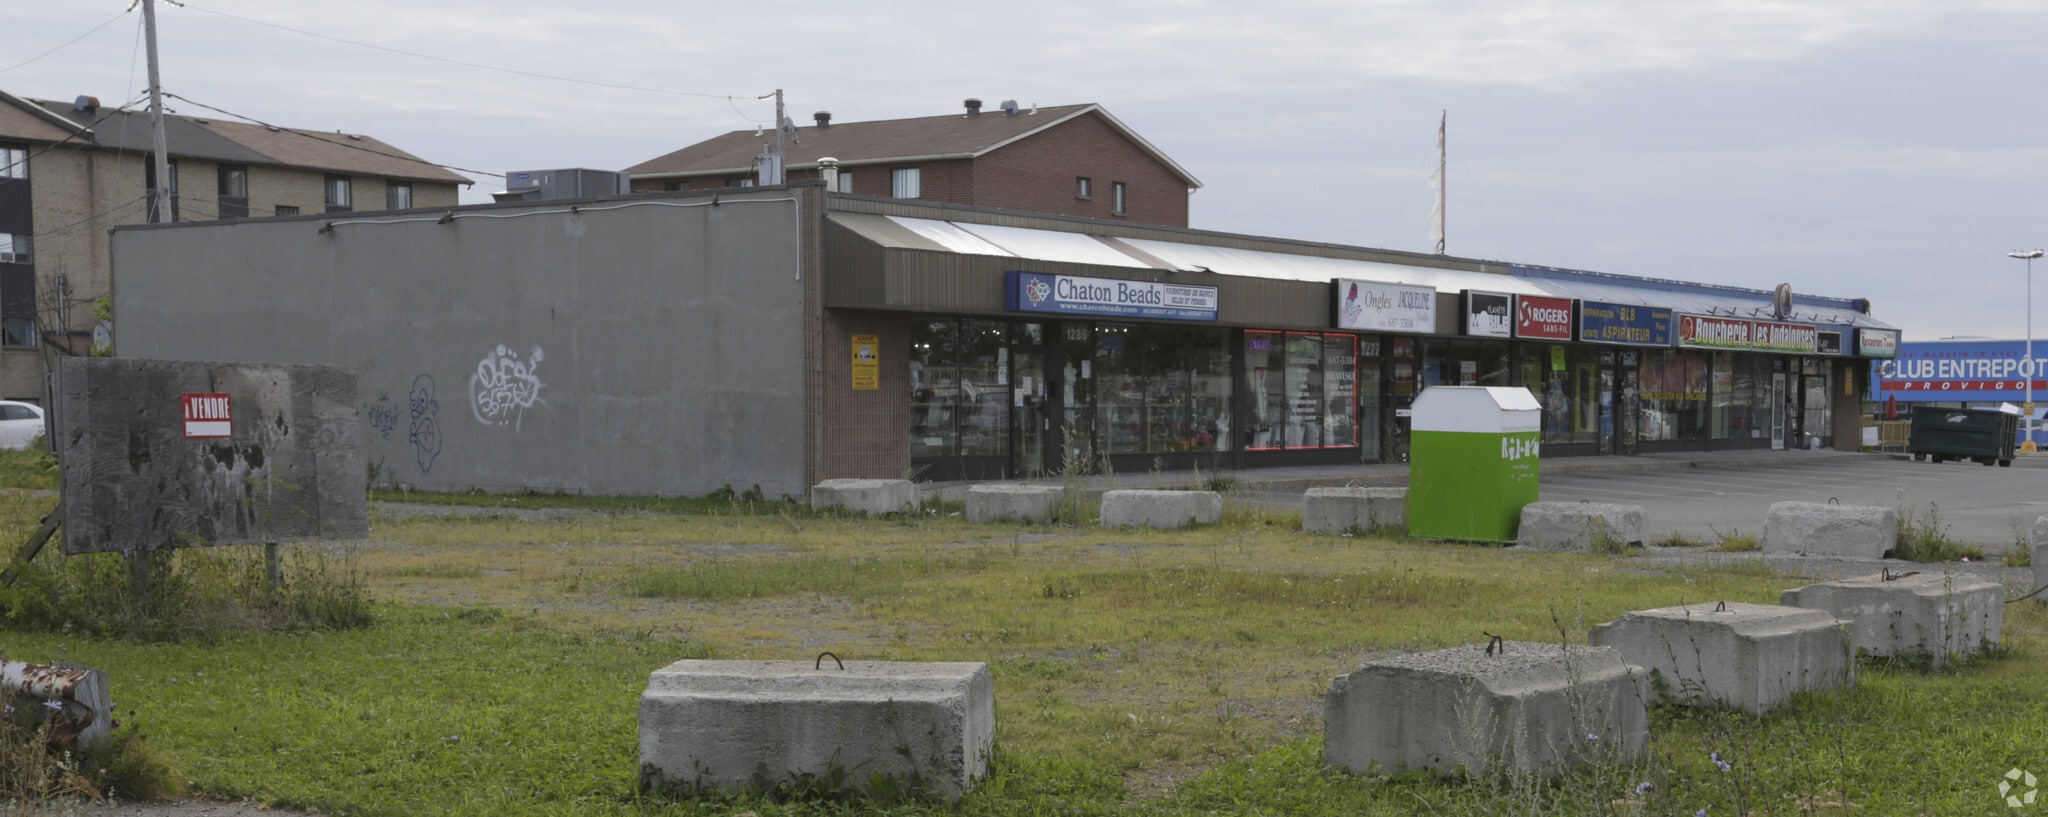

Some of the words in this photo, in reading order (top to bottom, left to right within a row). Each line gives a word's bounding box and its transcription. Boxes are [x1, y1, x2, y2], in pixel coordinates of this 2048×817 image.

[1057, 278, 1112, 301] Chaton
[1117, 282, 1161, 305] Beads
[1060, 303, 1137, 314] www.chatonbeads.com
[1364, 291, 1392, 313] Ongles
[1397, 291, 1430, 311] JACQUELINE
[1533, 308, 1568, 324] ROGERS
[1621, 307, 1635, 321] BLB
[1066, 328, 1087, 341] 1285
[1543, 324, 1568, 334] SANS-FIL
[1602, 326, 1650, 342] ASPIRATEUR
[1695, 317, 1748, 346] Boucherie
[1753, 323, 1768, 347] Les
[1769, 325, 1815, 350] Andalouses
[1881, 359, 1935, 379] CLUB
[1938, 354, 2048, 378] ENTREPÔT
[1904, 381, 2025, 390] PROVIGO
[191, 397, 230, 419] VENDRE
